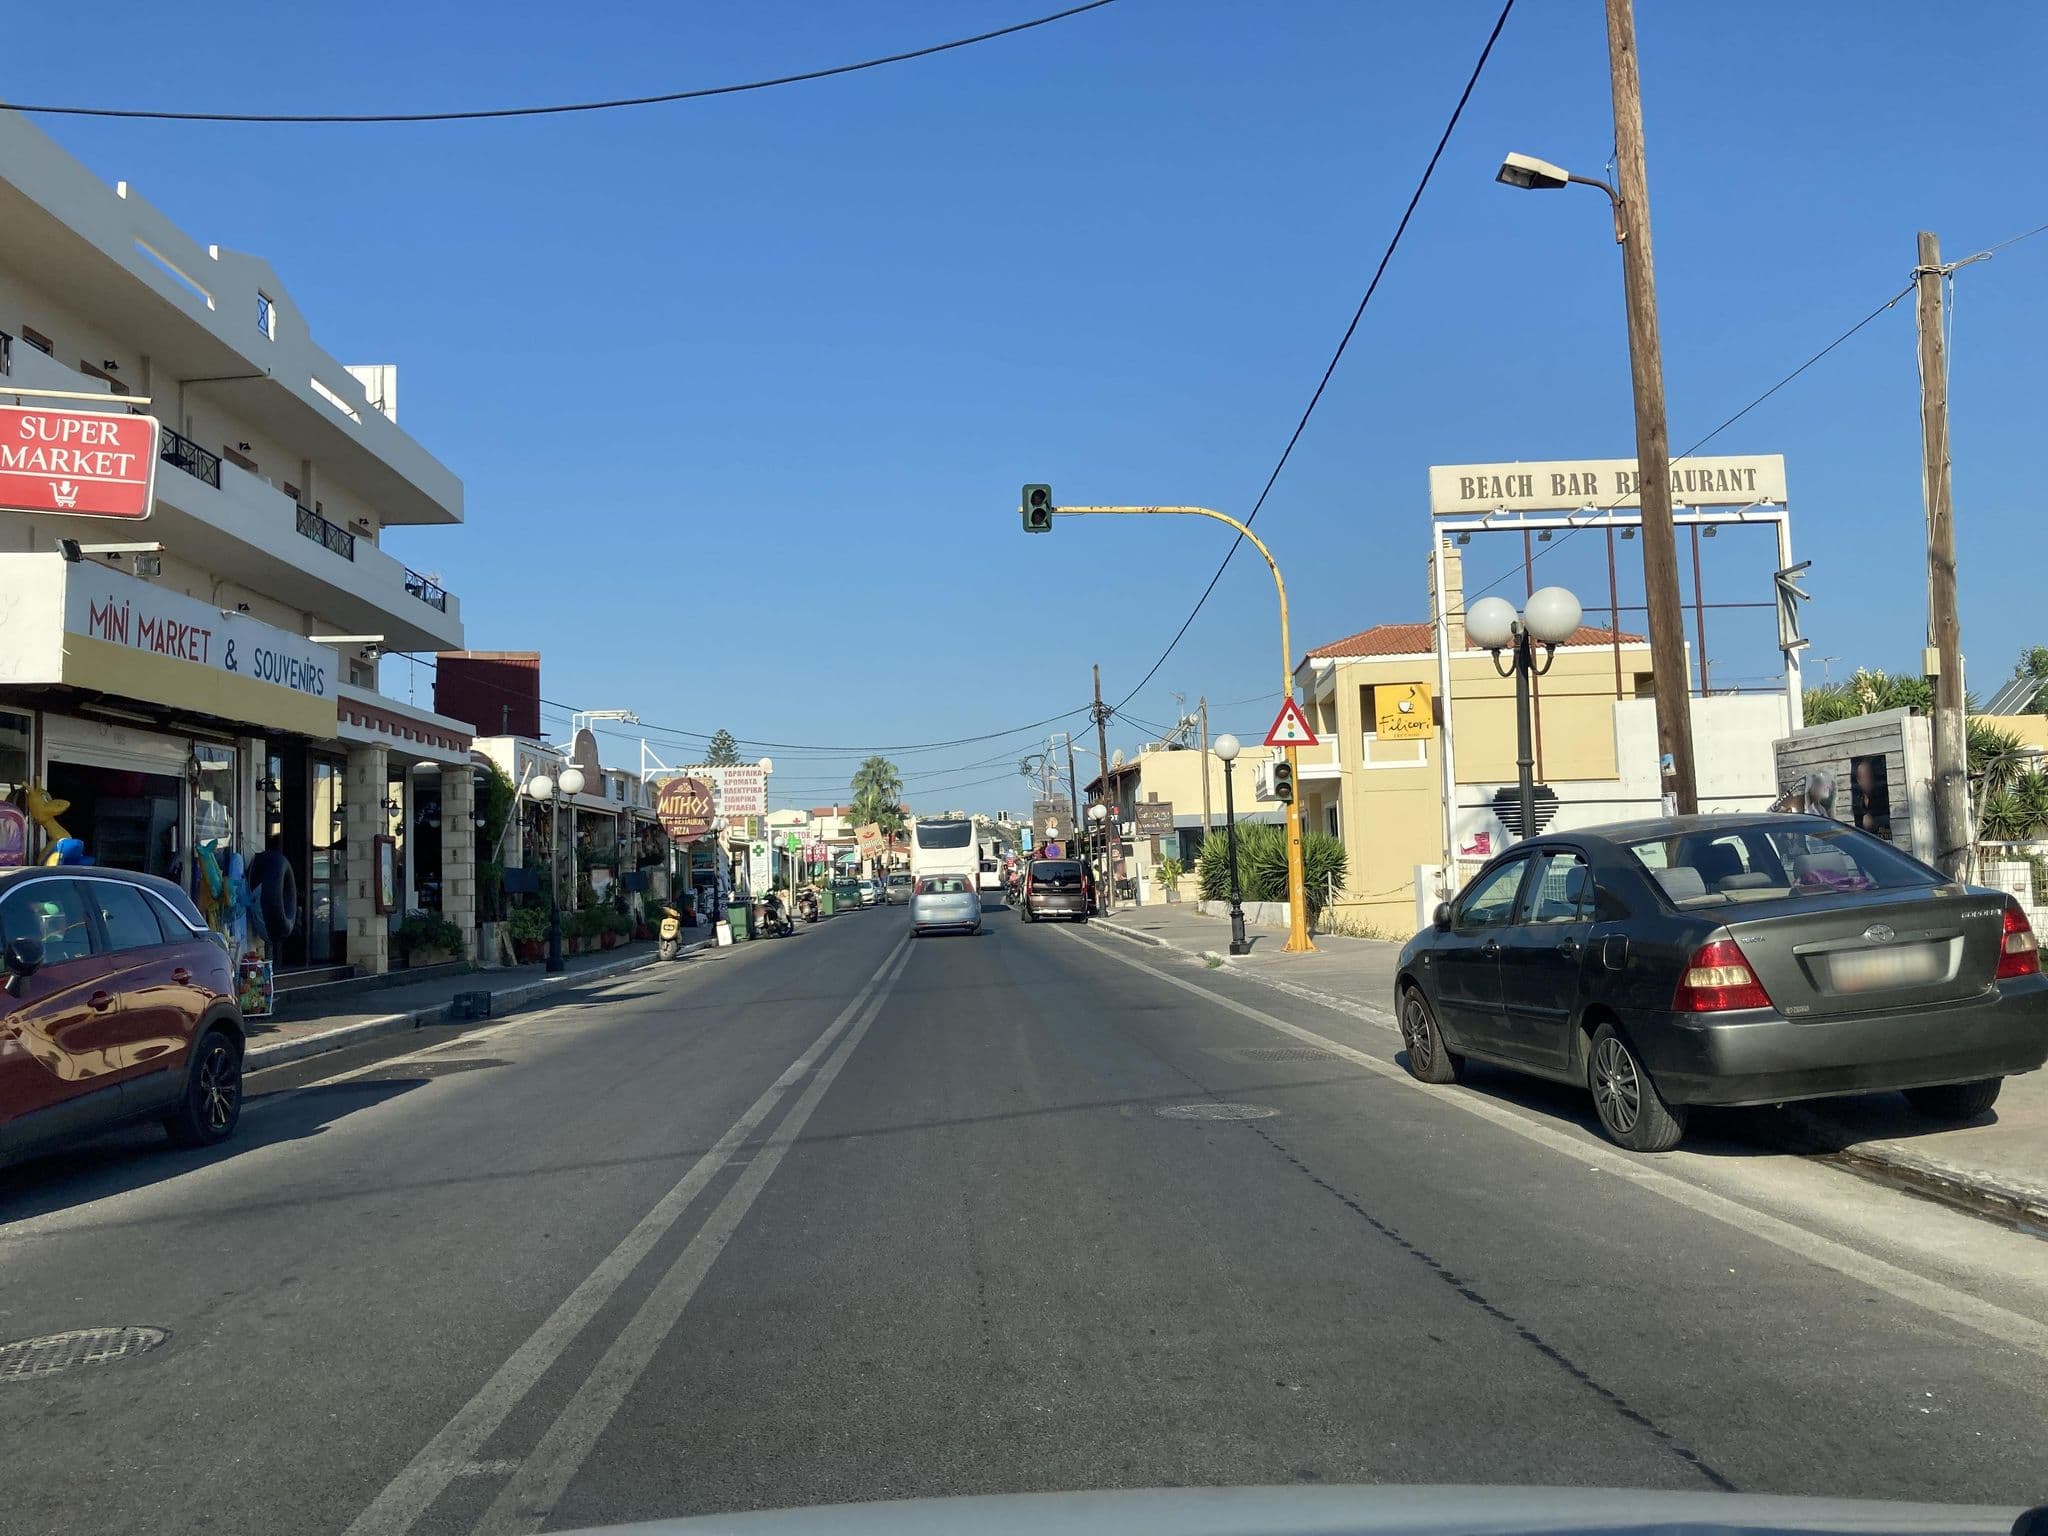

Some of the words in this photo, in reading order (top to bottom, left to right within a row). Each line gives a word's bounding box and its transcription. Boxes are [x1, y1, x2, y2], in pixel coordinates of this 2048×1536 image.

[19, 416, 120, 446] SUPER
[0, 444, 136, 477] MARKET
[1460, 475, 1534, 500] BEACH
[1551, 472, 1598, 497] BAR
[1615, 467, 1757, 495] REAURANT
[138, 612, 212, 664] MARKET
[225, 639, 238, 671] &
[1379, 714, 1431, 734] Filicori
[657, 796, 709, 815] MITHOS
